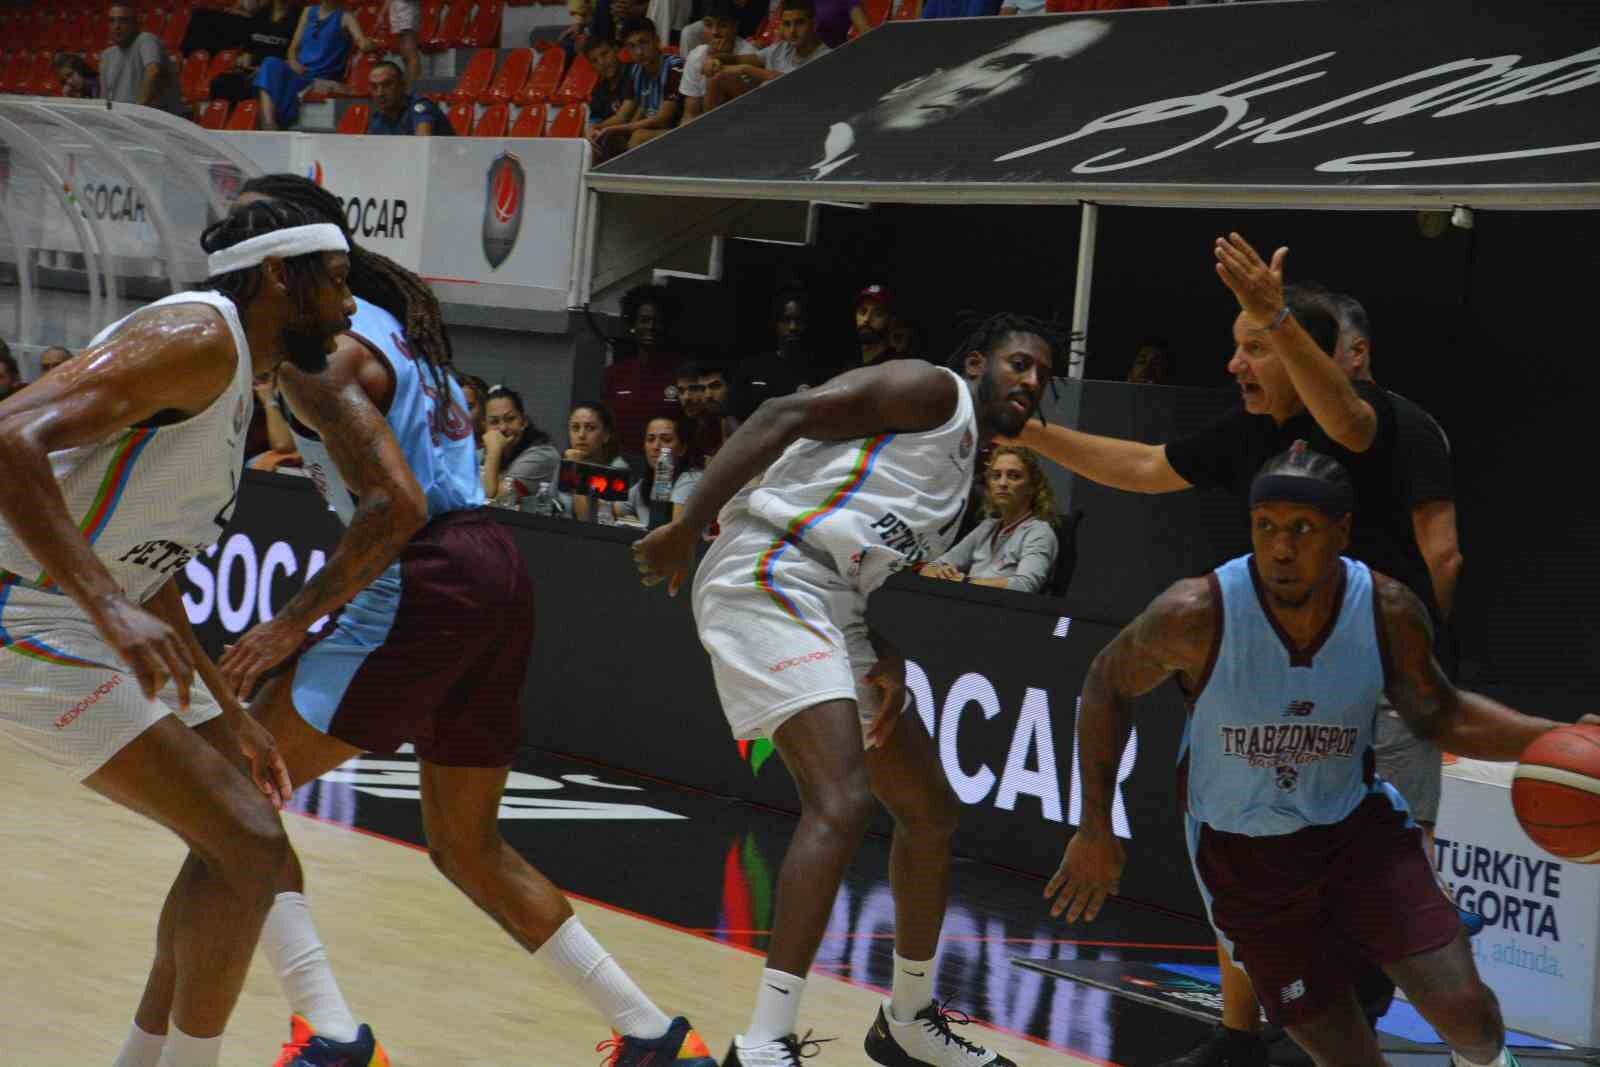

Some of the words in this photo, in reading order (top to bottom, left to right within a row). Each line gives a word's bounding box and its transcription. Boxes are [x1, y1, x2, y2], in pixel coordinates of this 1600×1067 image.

[338, 196, 408, 239] OCAR
[1220, 723, 1359, 757] TRABZONSPOR
[1434, 837, 1562, 899] TÜRKİYE
